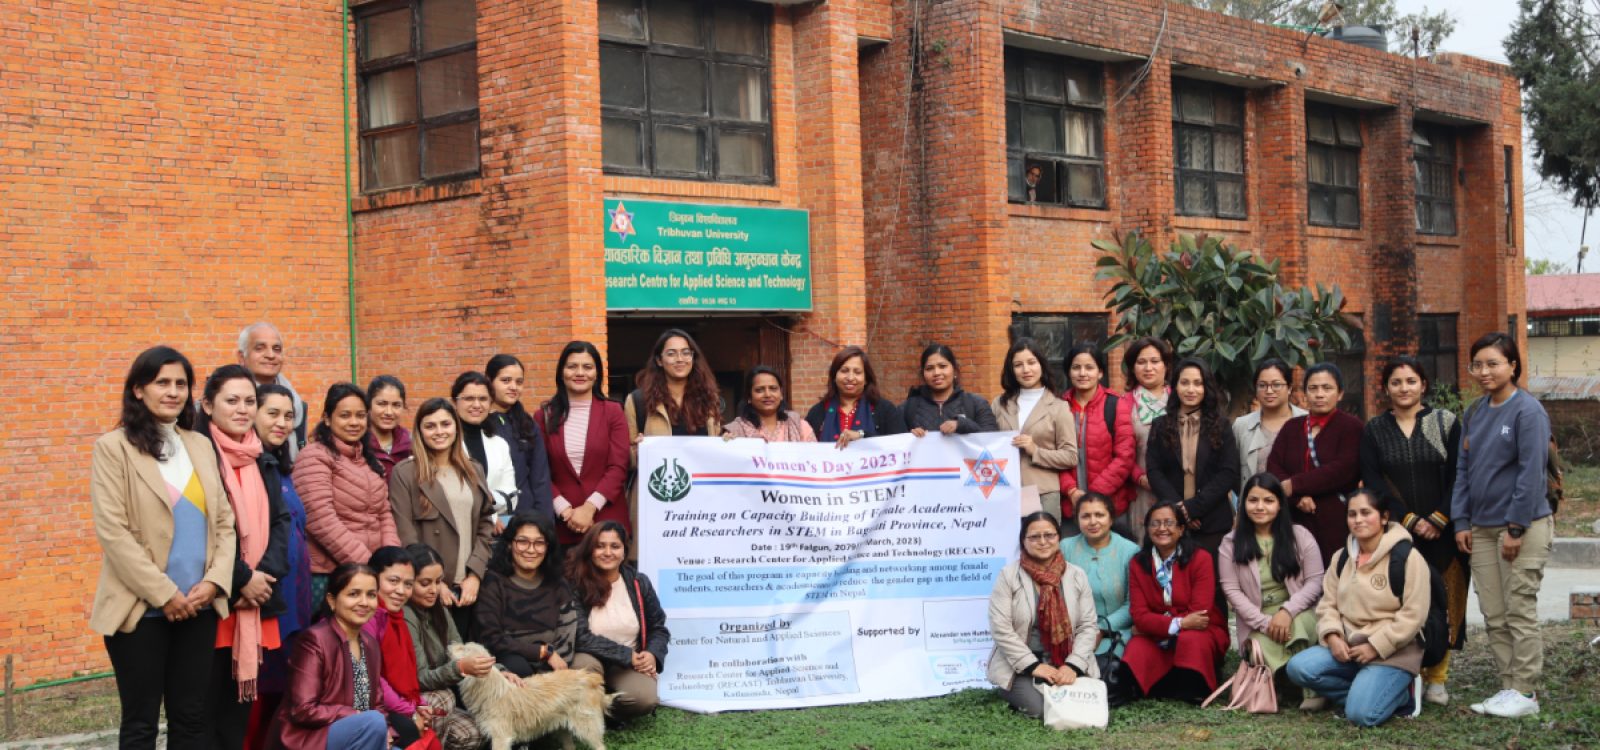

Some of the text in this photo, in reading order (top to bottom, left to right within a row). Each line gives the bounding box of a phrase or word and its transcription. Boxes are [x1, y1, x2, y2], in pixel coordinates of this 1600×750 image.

[657, 227, 749, 241] Tribhuvan University
[653, 244, 682, 266] विज्ञान
[684, 250, 703, 265] तथा
[605, 273, 806, 291] esearch Centre for Applied Science and Technology
[752, 455, 818, 473] Women's
[822, 460, 853, 475] Day
[860, 453, 897, 470] 2023
[760, 484, 906, 506] Women in STEM!
[664, 510, 717, 522] Training
[721, 511, 736, 520] on
[741, 509, 796, 522] Capacity
[800, 509, 850, 523] Building
[854, 509, 868, 521] of
[907, 502, 973, 514] Academics
[662, 526, 686, 537] and
[689, 524, 765, 537] Researchers
[769, 525, 781, 536] in
[785, 525, 827, 538] STEM
[830, 526, 842, 537] in
[890, 519, 947, 531] Province,
[951, 517, 987, 530] Nepal
[751, 543, 772, 551] Date
[799, 543, 832, 553] Falgun,
[896, 537, 922, 546] 2023)
[676, 556, 705, 565] Venue
[714, 555, 757, 564] Research
[759, 555, 789, 564] Center
[792, 554, 809, 563] for
[810, 554, 846, 565] Applied
[872, 549, 889, 558] and
[892, 548, 942, 559] Technology
[945, 546, 996, 556] (RECAST)
[677, 572, 693, 581] The
[695, 572, 715, 582] goal
[717, 571, 728, 580] of
[728, 571, 745, 580] this
[747, 572, 783, 582] program
[862, 564, 878, 573] and
[879, 564, 927, 574] networking
[929, 564, 957, 573] among
[960, 561, 989, 571] female
[674, 584, 713, 593] students,
[715, 583, 764, 592] researchers
[765, 583, 773, 591] &
[840, 577, 868, 586] reduce
[872, 576, 885, 584] the
[886, 576, 915, 586] gender
[917, 576, 932, 585] gap
[946, 574, 958, 582] the
[960, 573, 981, 581] field
[982, 573, 993, 581] of
[719, 619, 792, 633] Organized by
[857, 626, 920, 637] Supported by
[669, 629, 841, 646] Center for Natural and Applied Sciences
[709, 653, 807, 668] In collaboration with
[676, 672, 714, 680] Research
[760, 666, 790, 676] Applied
[825, 662, 839, 670] and
[669, 682, 714, 691] Technology
[767, 677, 806, 686] Tribhuvan
[775, 686, 800, 696] Nepal
